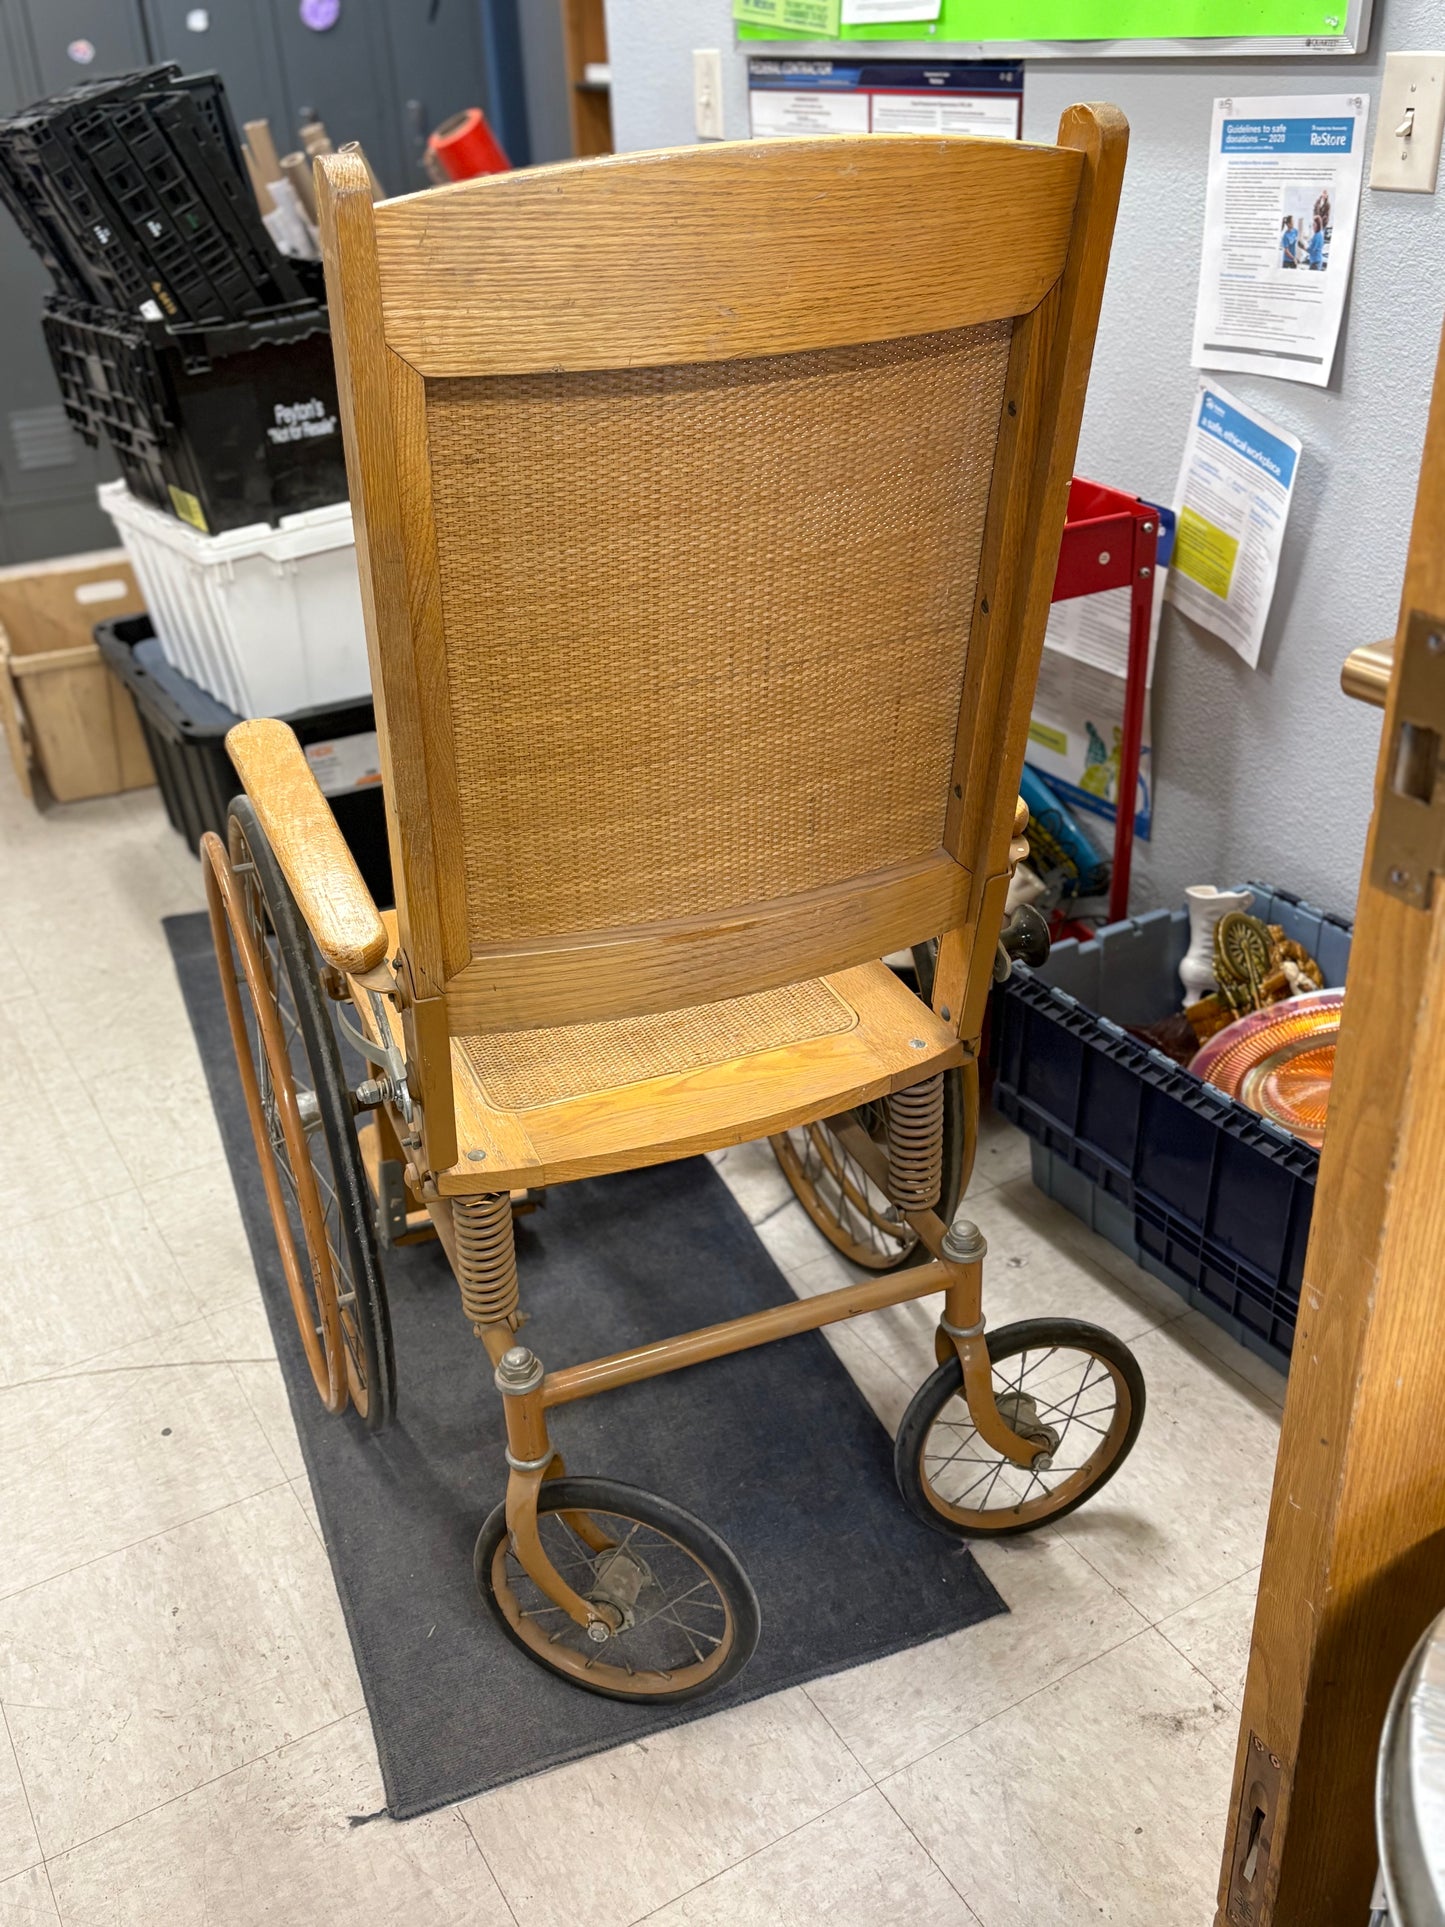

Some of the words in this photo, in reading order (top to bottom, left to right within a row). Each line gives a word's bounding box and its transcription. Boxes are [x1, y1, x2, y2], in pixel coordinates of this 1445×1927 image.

[1227, 124, 1261, 134] Guidelines
[1263, 125, 1271, 133] to
[1271, 123, 1287, 133] safe
[1226, 134, 1258, 144] donations
[1268, 133, 1286, 143] 2020
[1310, 132, 1347, 146] ReStore
[274, 397, 326, 426] Peyton's
